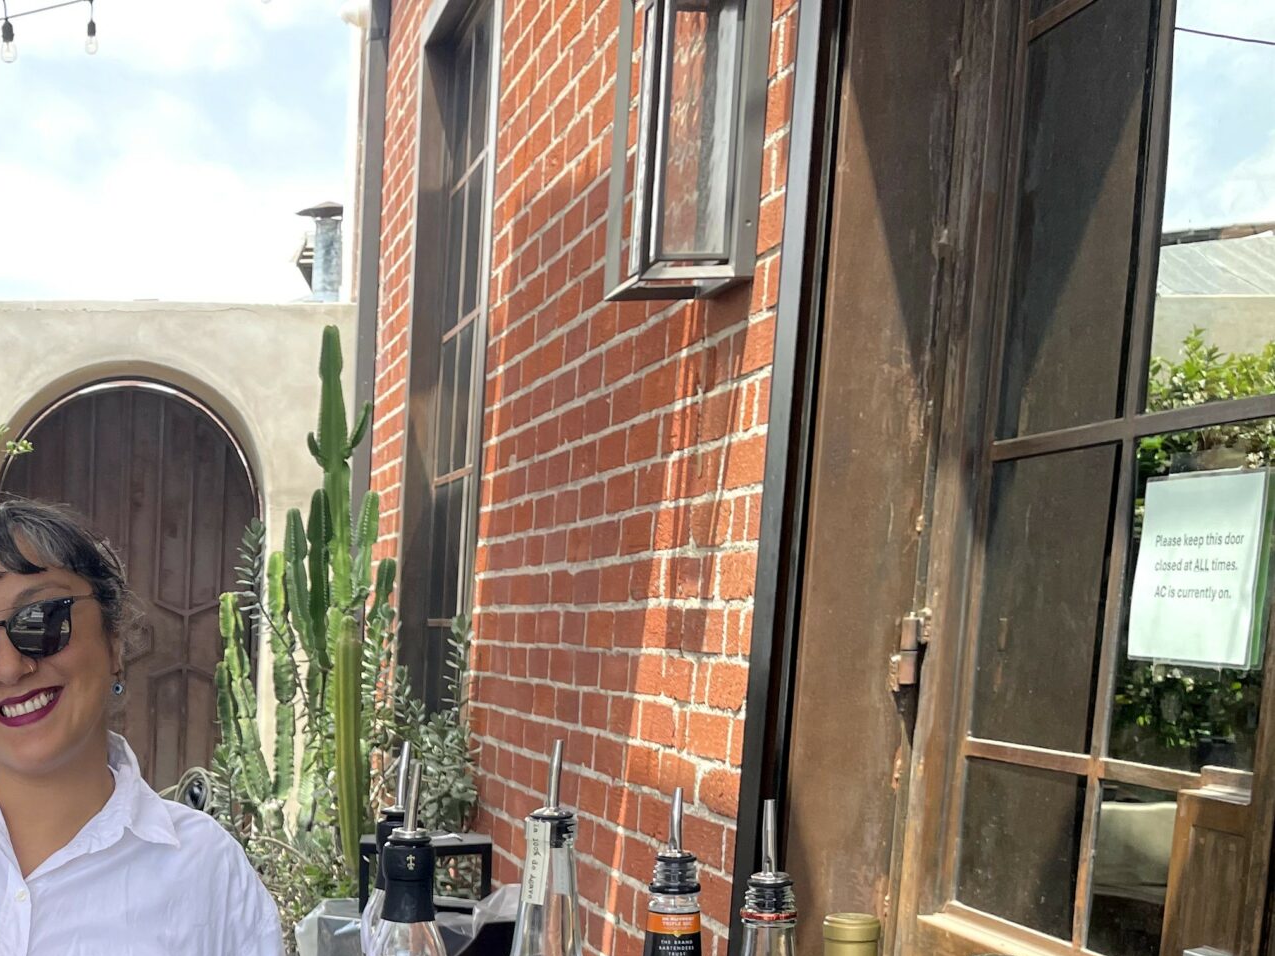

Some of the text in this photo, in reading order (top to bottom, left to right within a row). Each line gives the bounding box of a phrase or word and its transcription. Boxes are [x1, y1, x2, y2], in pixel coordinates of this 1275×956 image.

[1155, 532, 1244, 549] Please keep this door
[1155, 558, 1238, 571] closed at ALL times.
[1154, 586, 1232, 602] AC is currently on.
